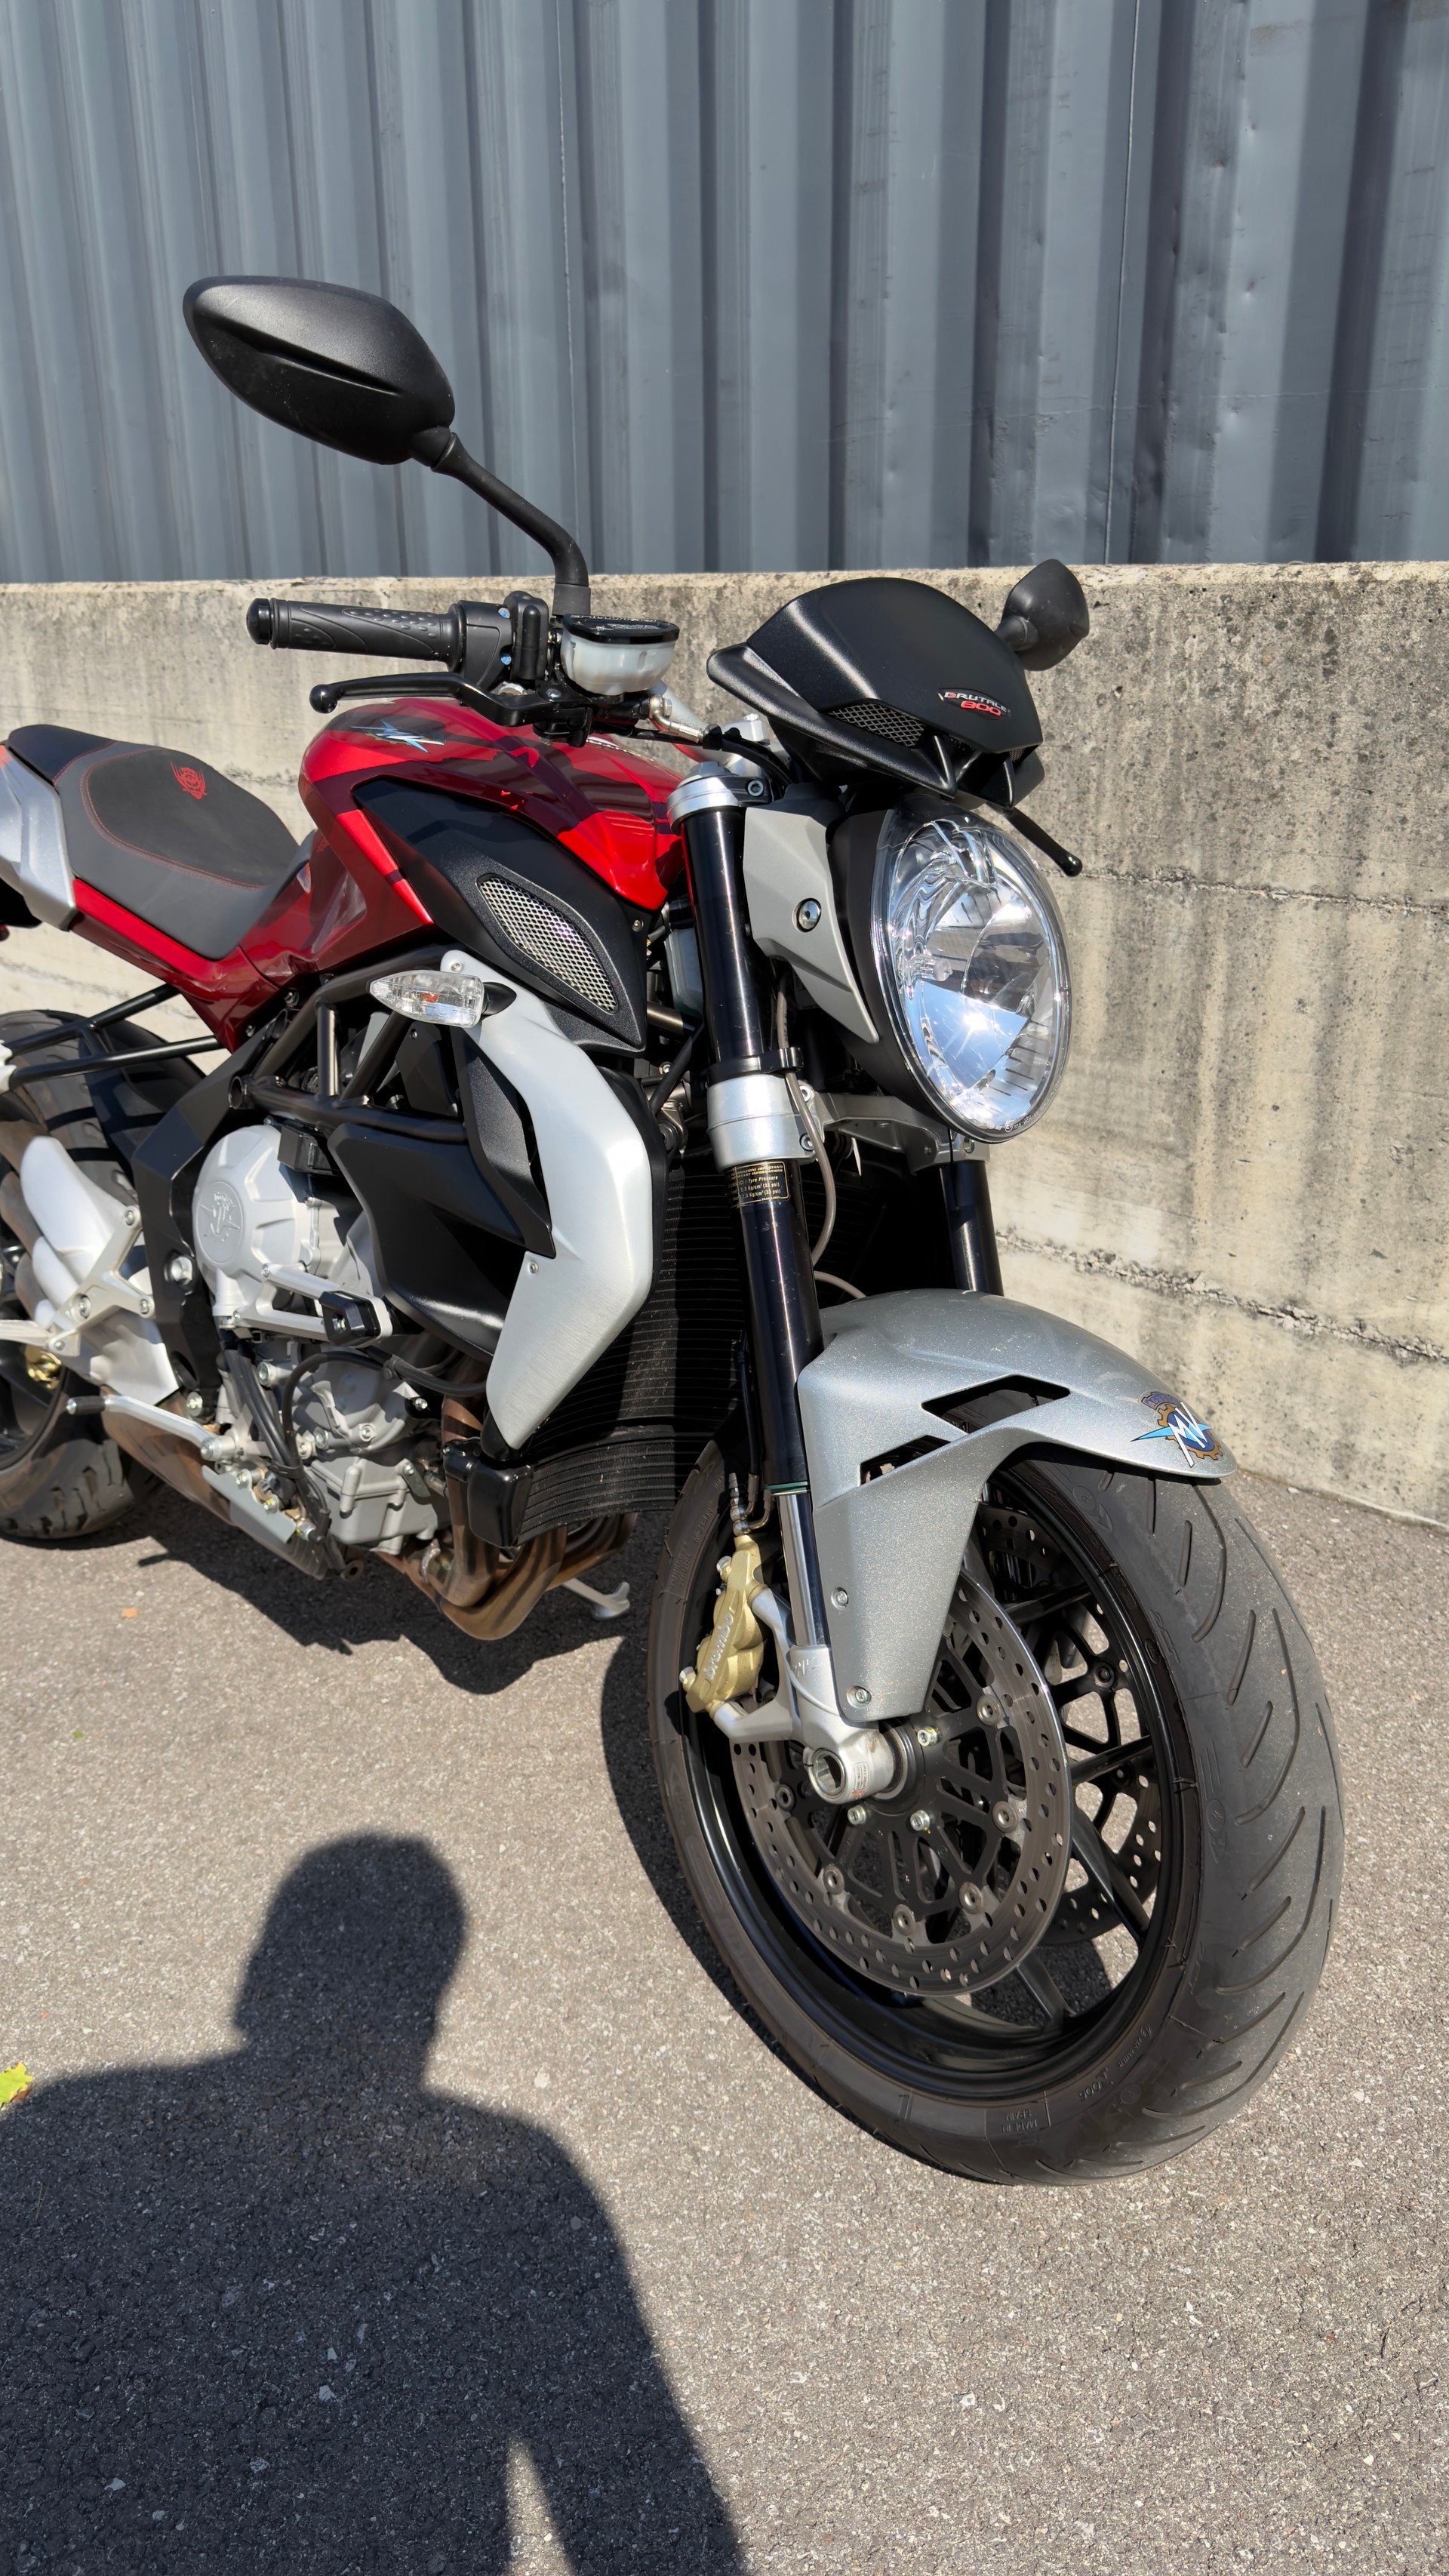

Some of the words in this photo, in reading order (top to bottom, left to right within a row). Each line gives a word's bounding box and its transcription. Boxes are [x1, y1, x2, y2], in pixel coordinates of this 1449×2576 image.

[944, 692, 1007, 712] BRUTALE
[961, 700, 1001, 716] 800
[703, 1613, 734, 1680] brembo
[1004, 2108, 1032, 2121] SPAIN
[1001, 2124, 1011, 2133] IN
[1016, 2119, 1037, 2132] MADE
